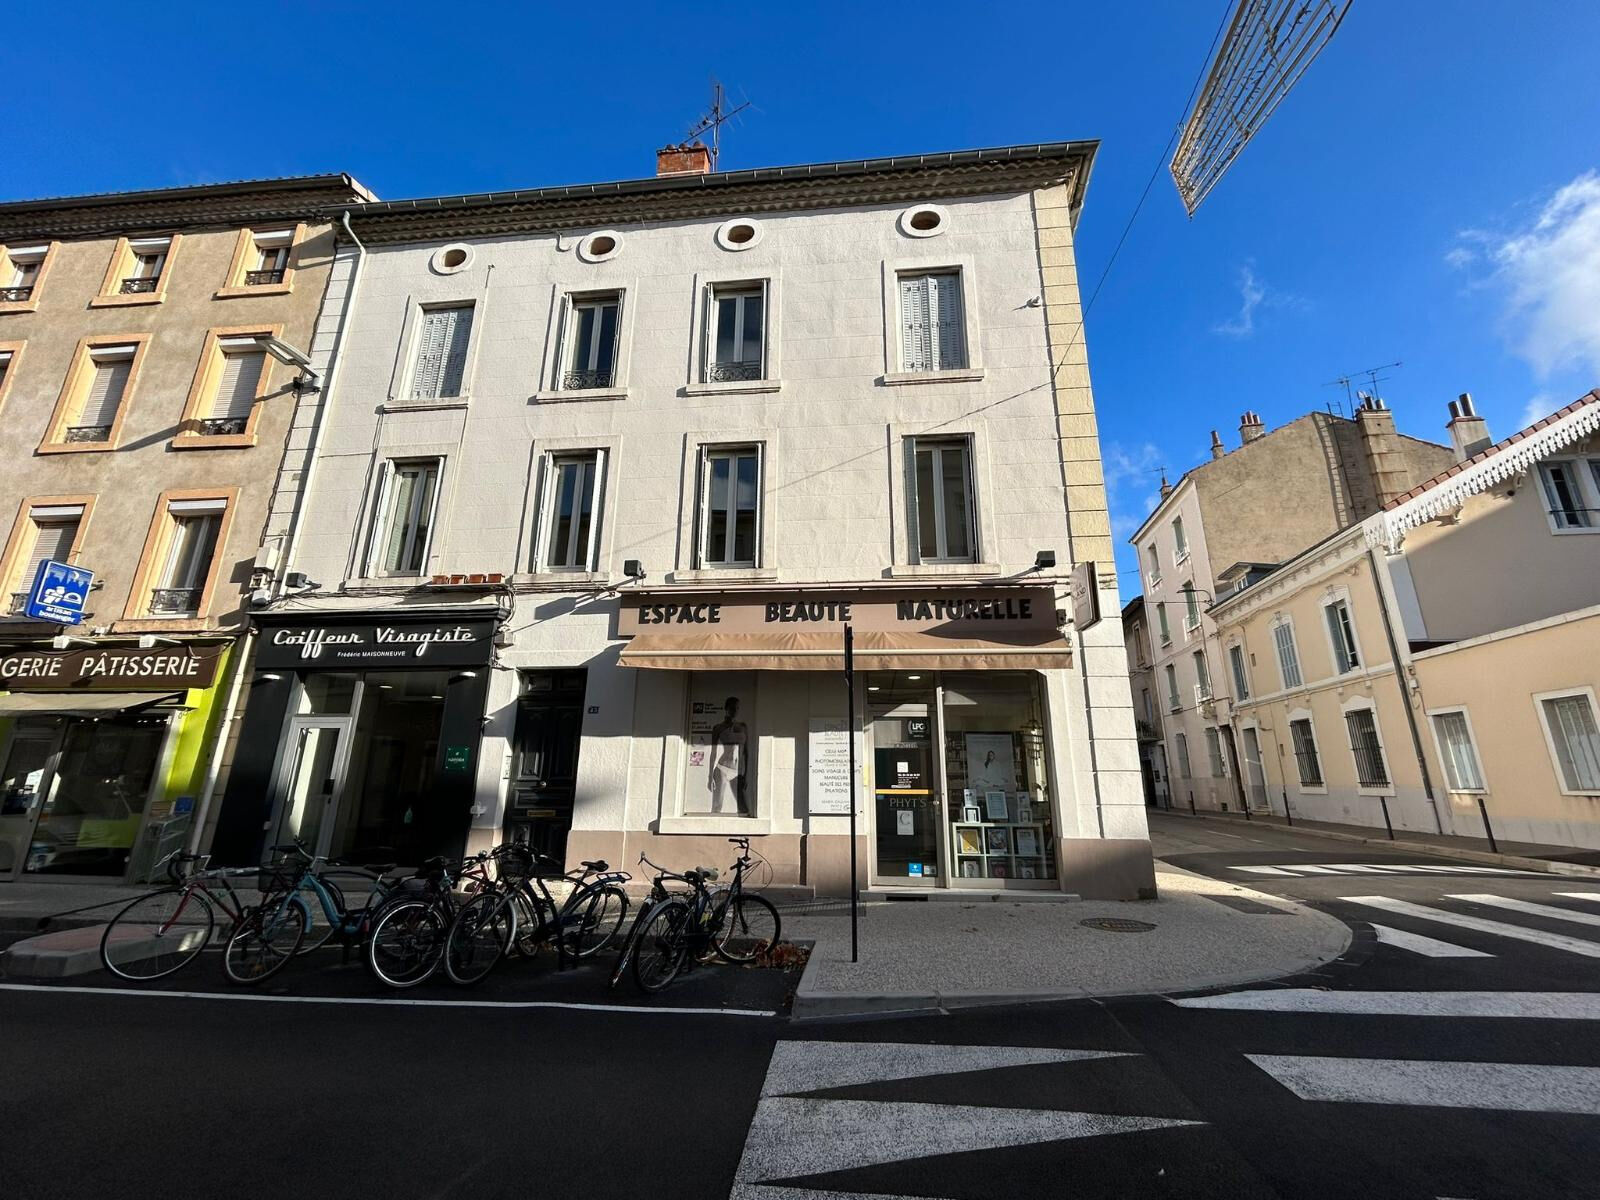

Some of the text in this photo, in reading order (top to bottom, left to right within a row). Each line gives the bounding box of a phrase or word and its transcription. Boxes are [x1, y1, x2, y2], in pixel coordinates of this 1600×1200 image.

[38, 609, 75, 623] boulanger
[46, 606, 72, 616] artisan
[638, 598, 1033, 624] ESPACE BEAUTE NATURELLE
[273, 626, 477, 659] Coiffeur Visagiste
[362, 650, 406, 658] MAISONNEUVE
[80, 652, 202, 676] PÂTISSERIE
